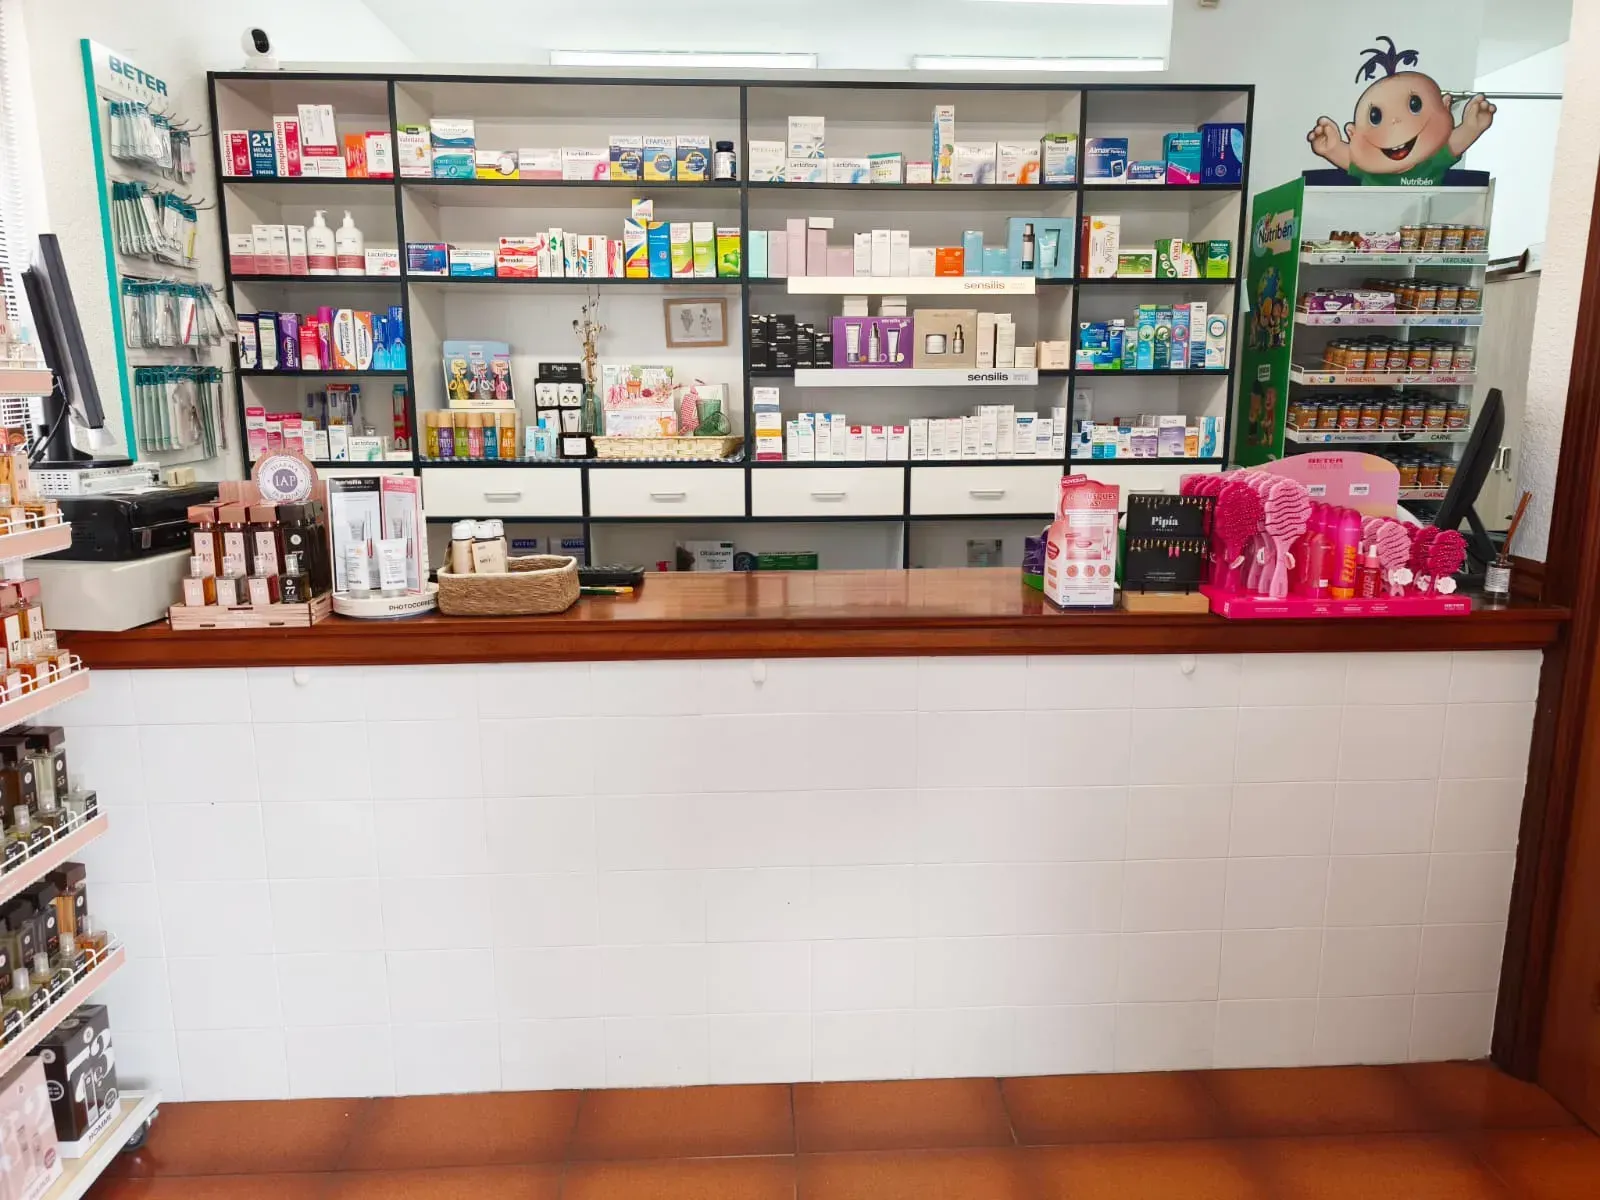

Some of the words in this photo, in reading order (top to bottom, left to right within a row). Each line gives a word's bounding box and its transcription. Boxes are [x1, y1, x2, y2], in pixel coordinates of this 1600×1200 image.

[108, 55, 168, 96] BETER
[1400, 176, 1433, 186] Nutribén
[1258, 221, 1293, 243] Nutribén
[964, 280, 1006, 290] sensilis
[967, 371, 1009, 381] sensilis
[1151, 515, 1179, 528] Pipía
[285, 586, 296, 596] 77
[88, 1114, 113, 1141] HOMME
